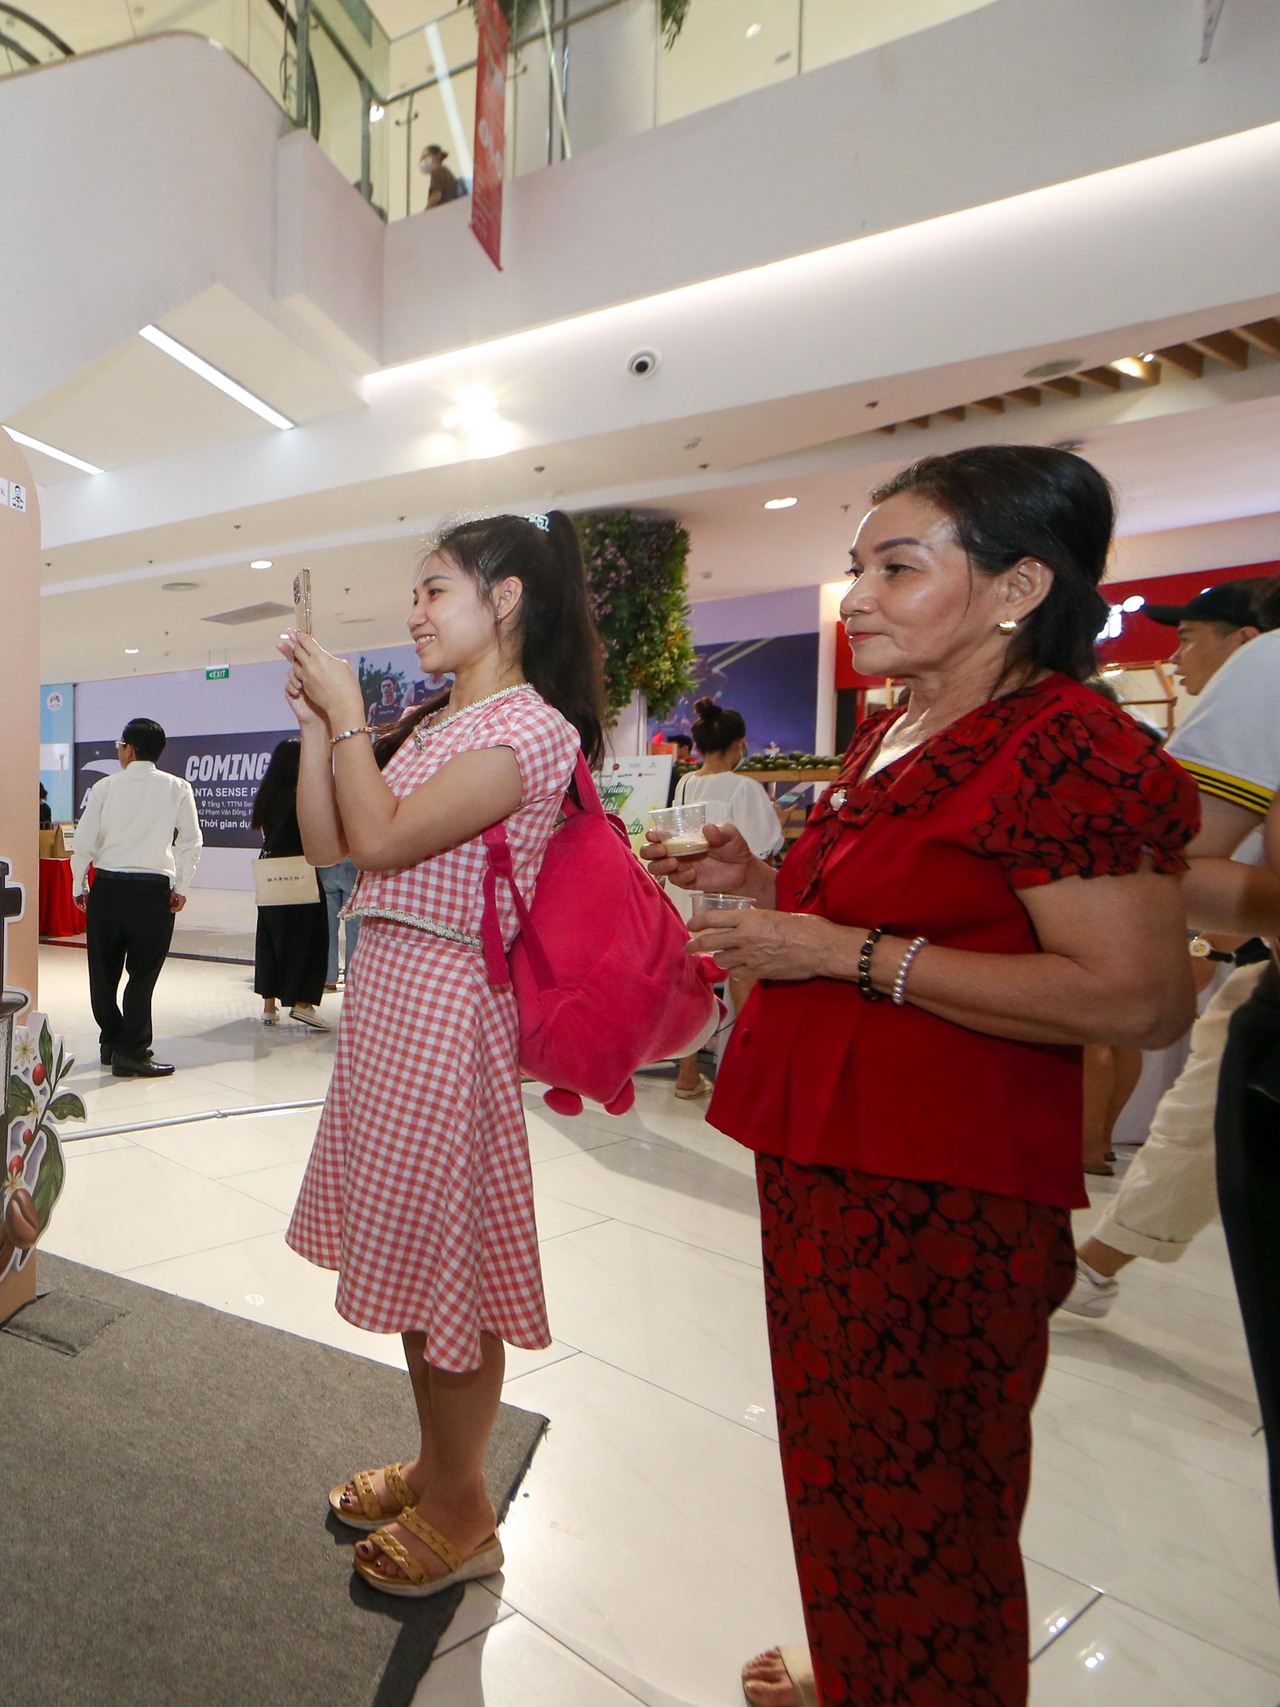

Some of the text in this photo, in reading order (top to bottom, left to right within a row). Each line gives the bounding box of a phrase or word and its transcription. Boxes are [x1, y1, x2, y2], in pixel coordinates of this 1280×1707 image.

[185, 752, 272, 782] COMING
[194, 786, 259, 797] NTA SENSE P
[219, 819, 237, 830] gian
